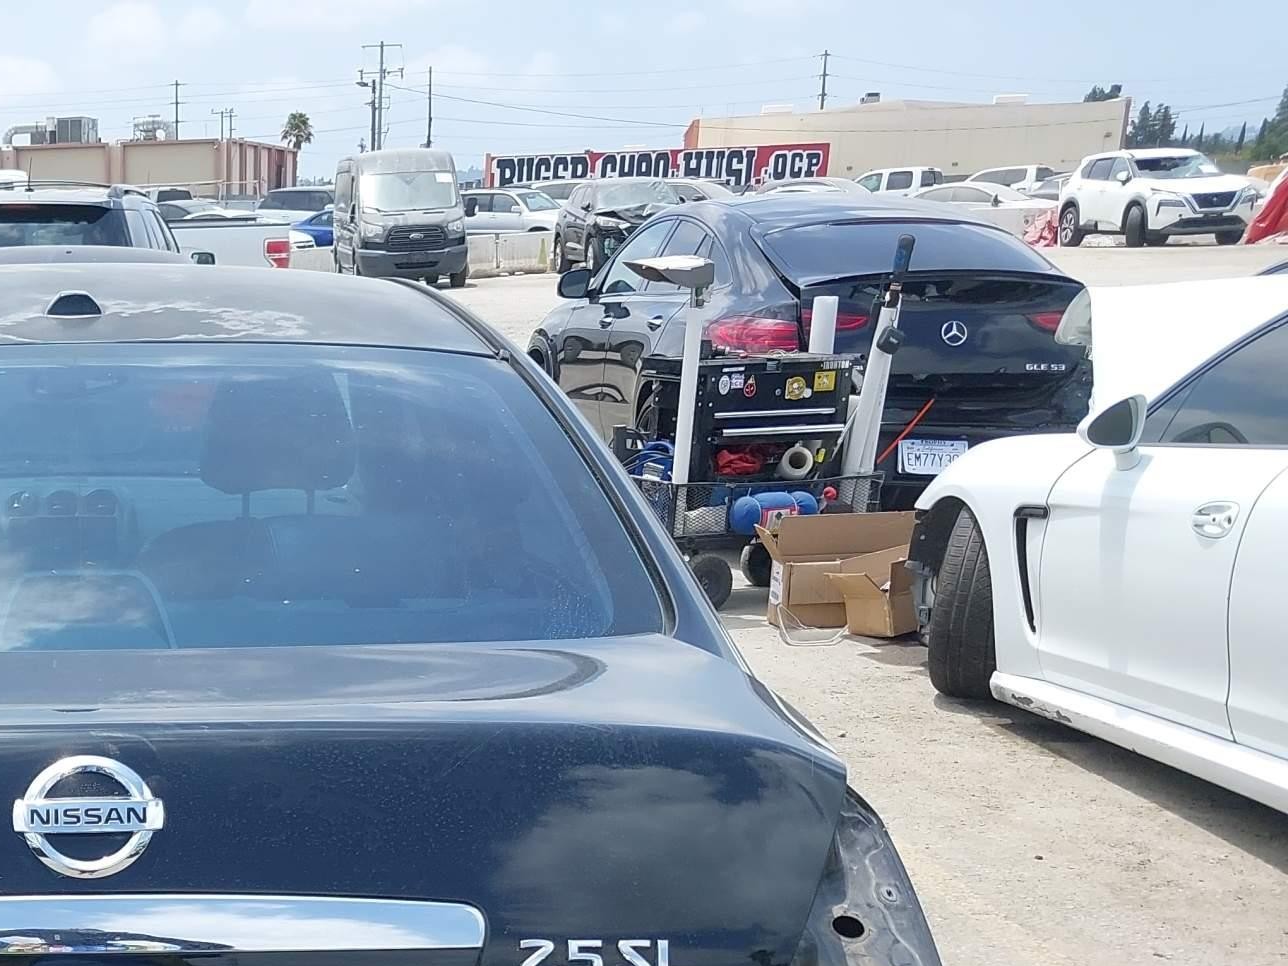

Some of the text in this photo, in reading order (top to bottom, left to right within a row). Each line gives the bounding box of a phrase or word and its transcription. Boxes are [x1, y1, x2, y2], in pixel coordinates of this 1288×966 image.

[1025, 363, 1066, 371] GLE 53
[30, 807, 147, 825] NISSAN
